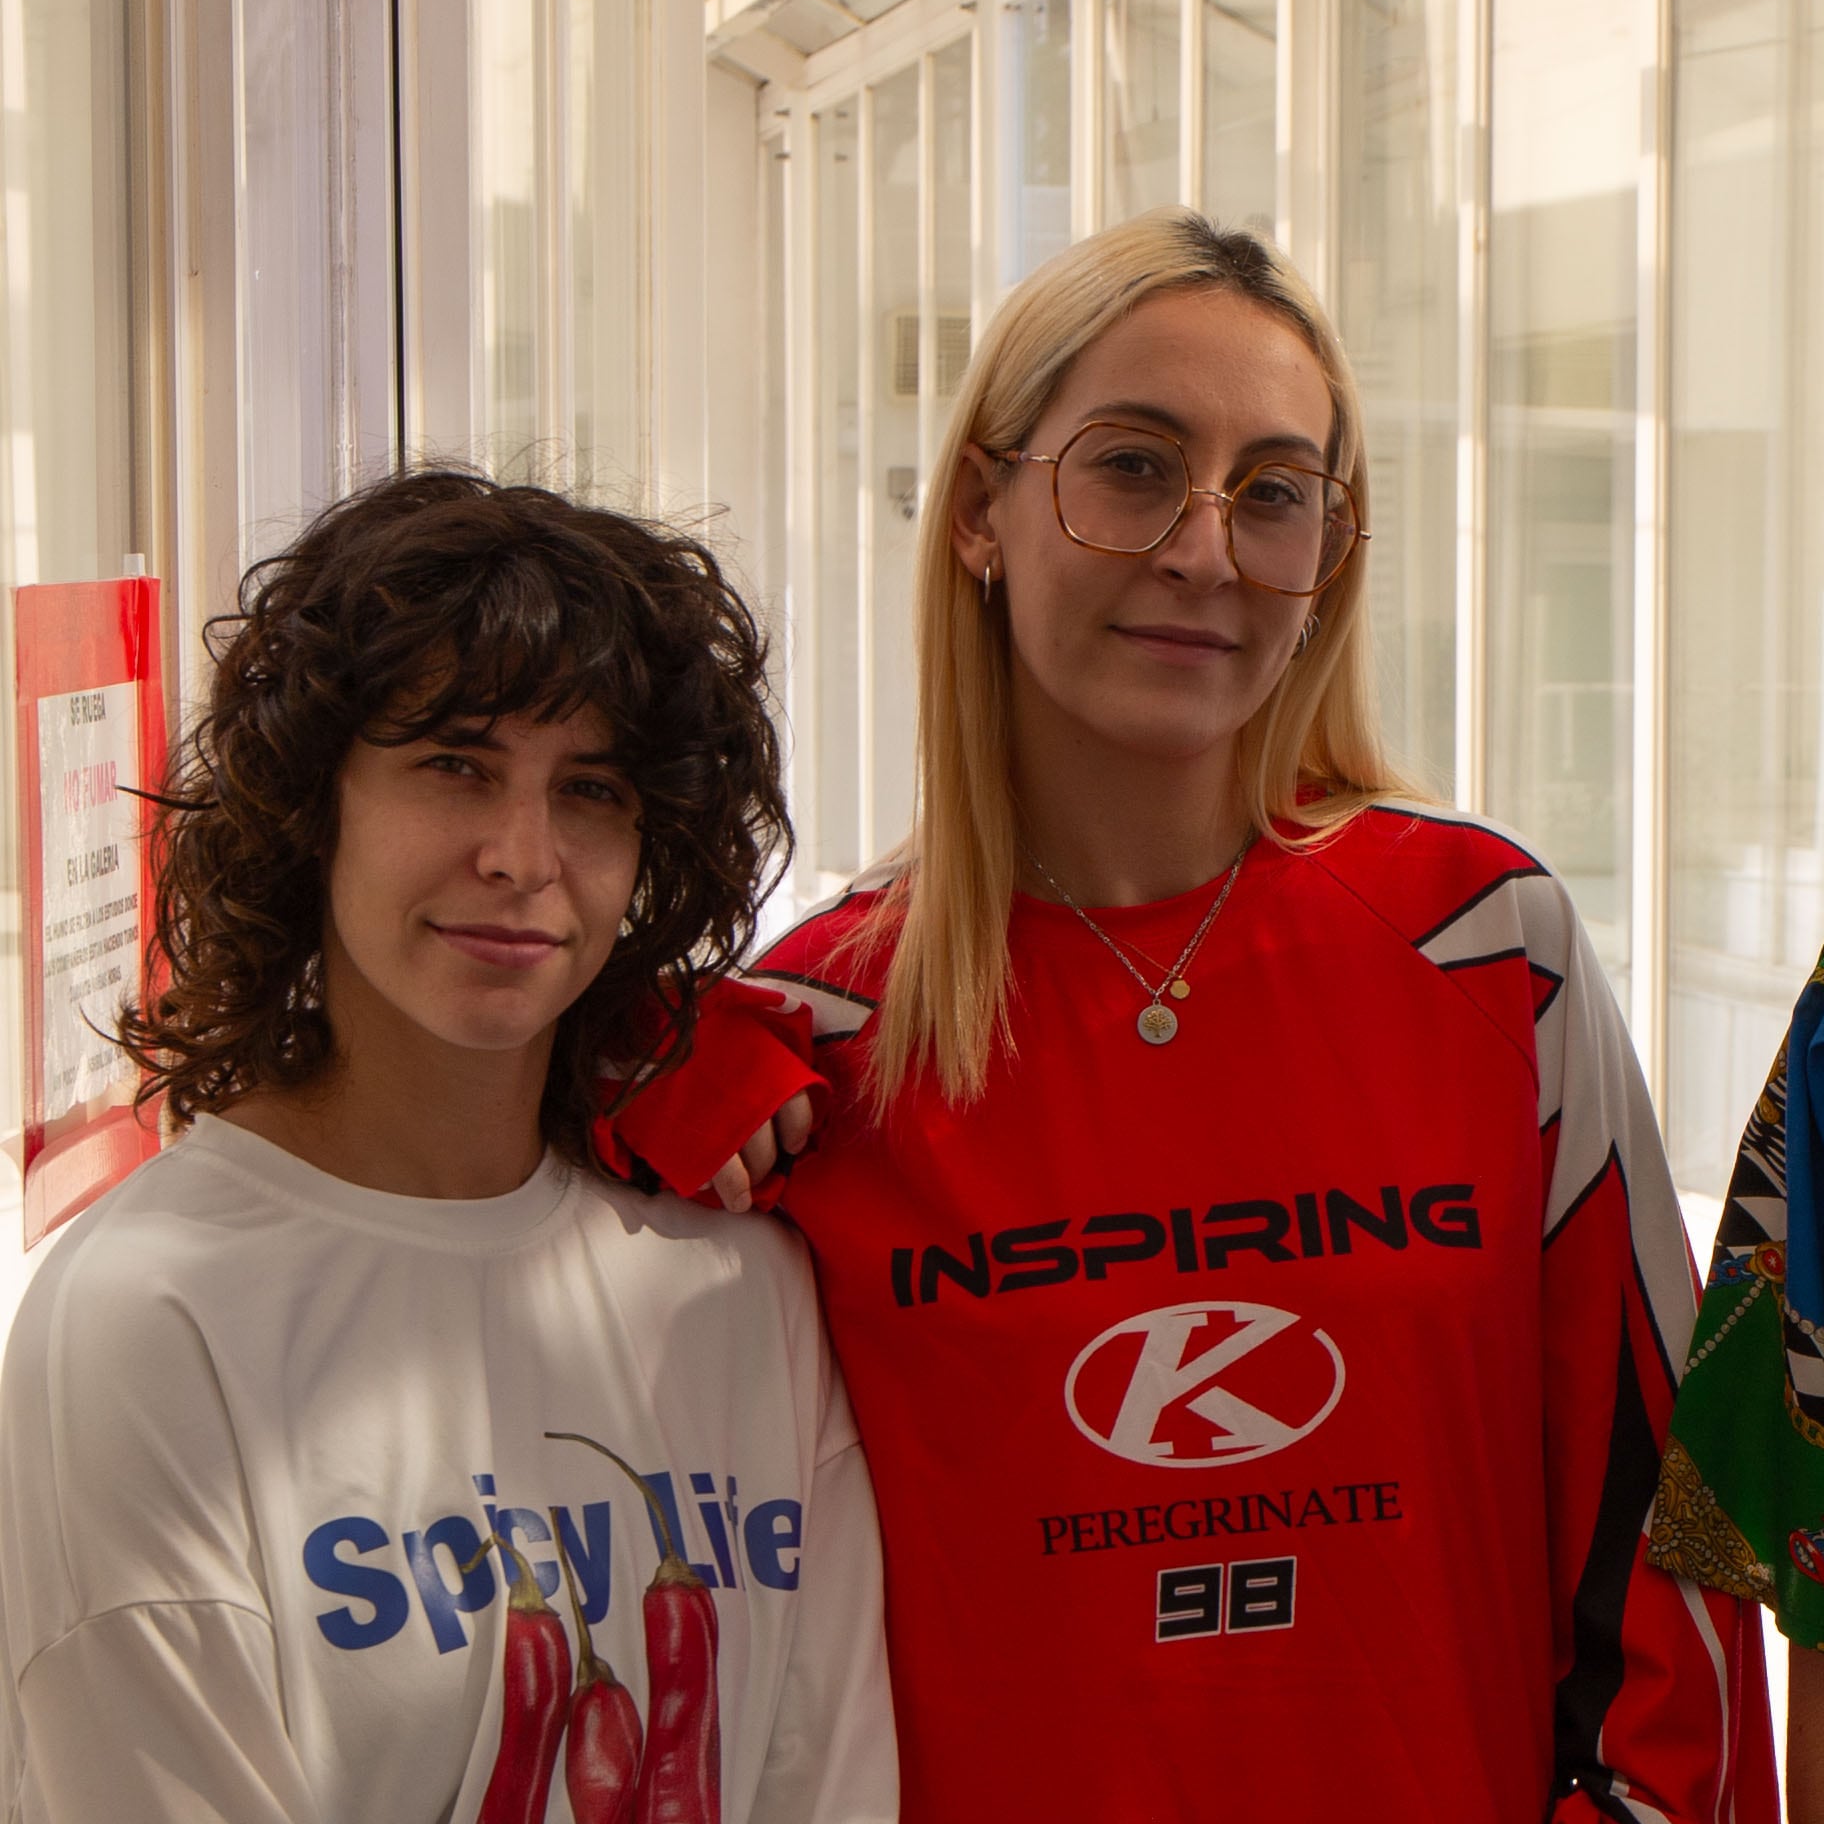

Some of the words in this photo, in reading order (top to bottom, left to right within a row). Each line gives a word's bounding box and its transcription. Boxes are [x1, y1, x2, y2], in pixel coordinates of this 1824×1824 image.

[70, 696, 80, 726] SE
[81, 692, 107, 724] RUEGA
[64, 769, 80, 814] NO
[82, 761, 118, 810] FUMAR
[67, 856, 78, 887] EN
[79, 853, 89, 883] LA
[890, 1183, 1483, 1307] INSPIRING
[1100, 1302, 1302, 1462] K
[1038, 1482, 1403, 1556] PEREGRINATE
[302, 1473, 611, 1654] Spicy
[1155, 1555, 1297, 1643] 98
